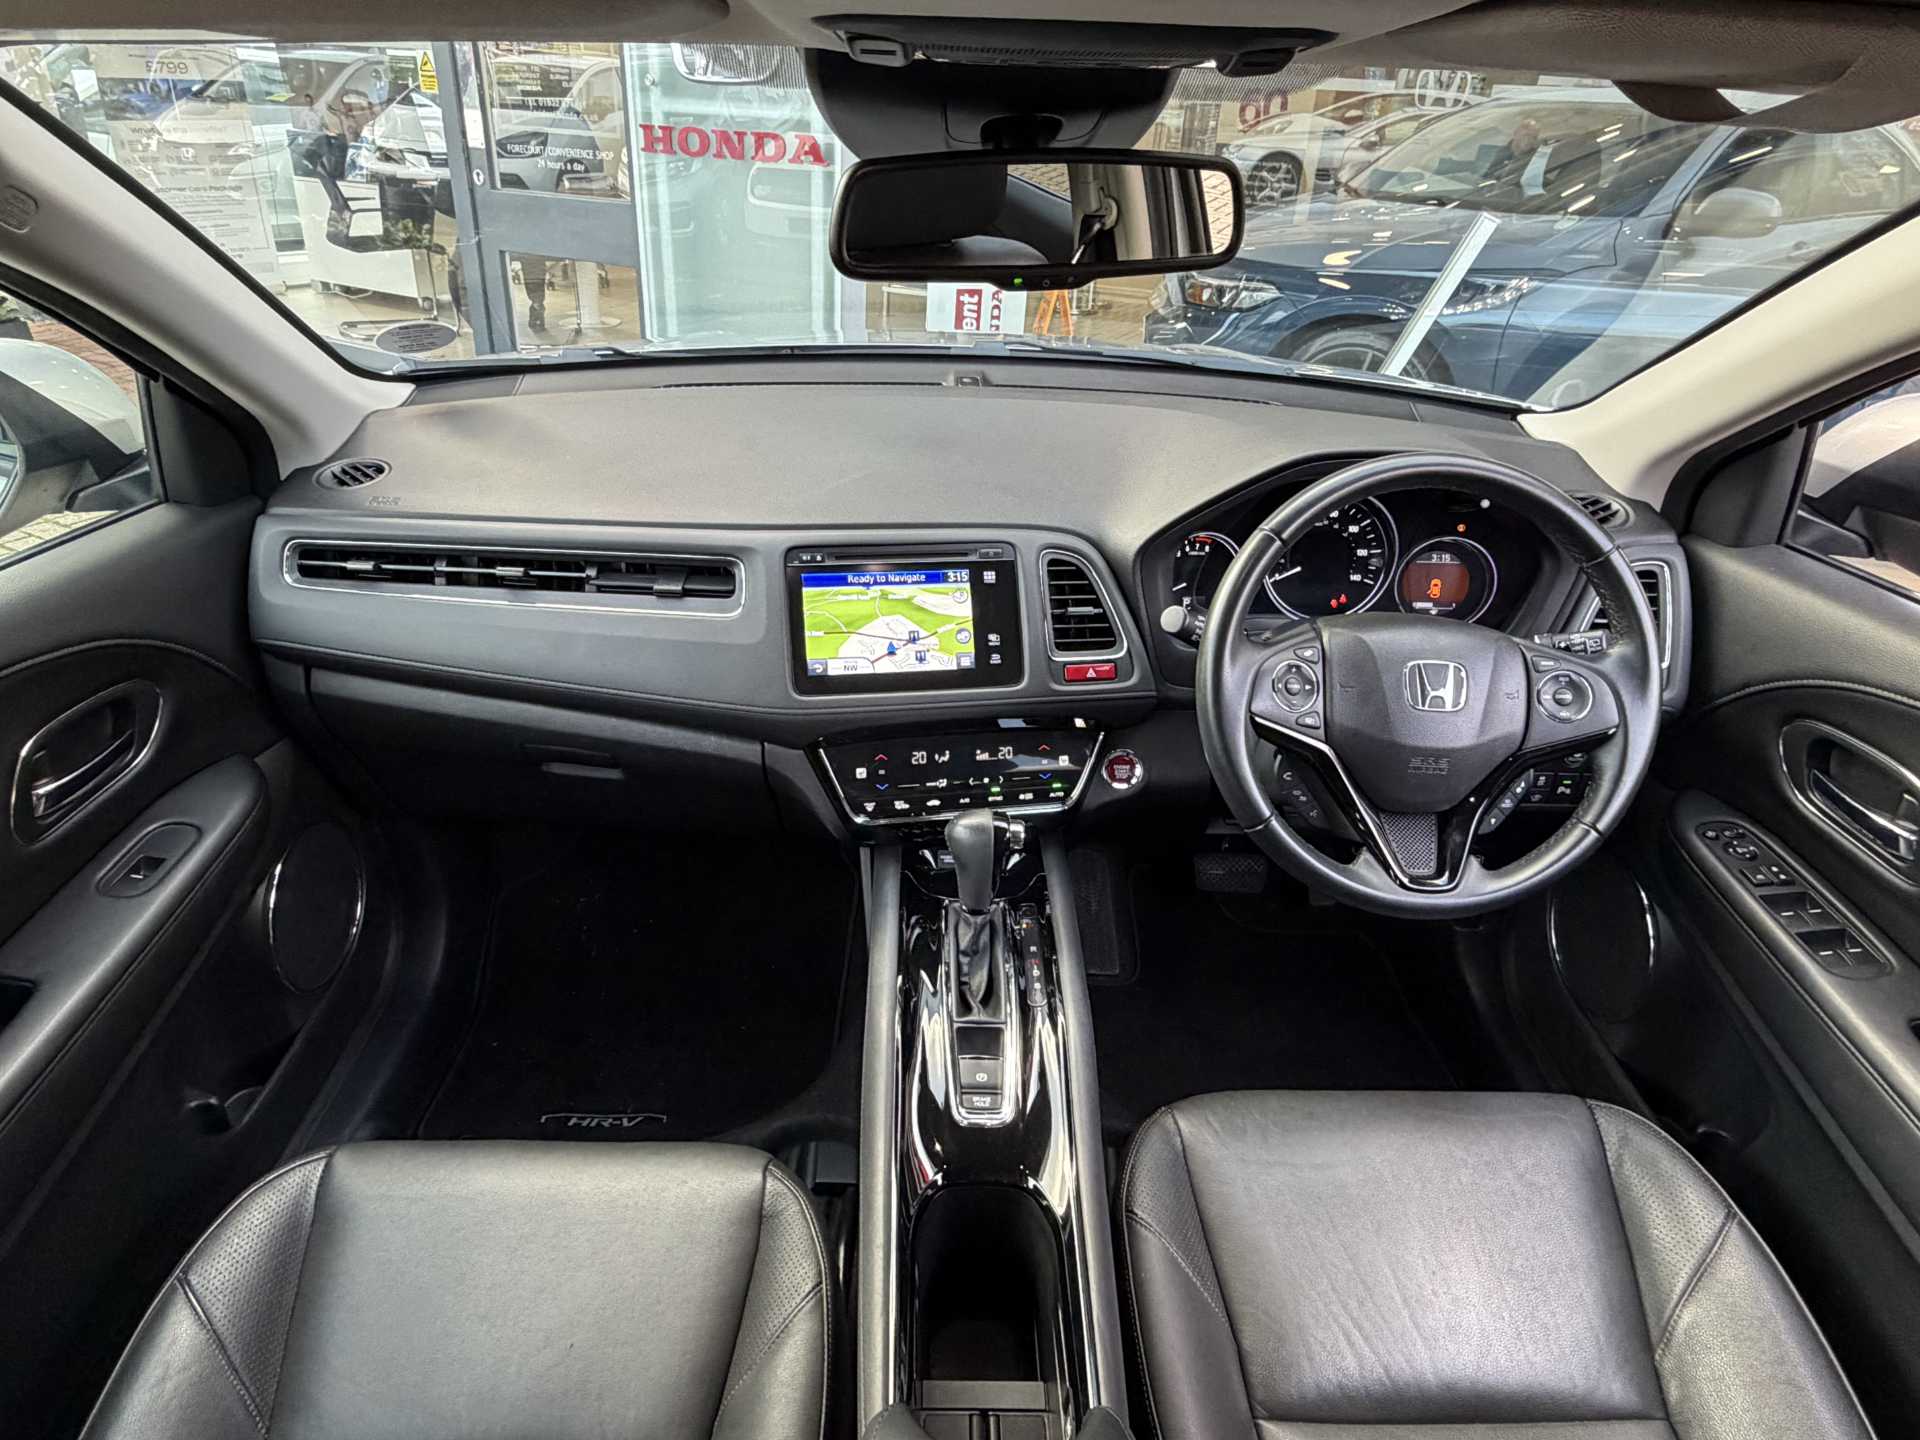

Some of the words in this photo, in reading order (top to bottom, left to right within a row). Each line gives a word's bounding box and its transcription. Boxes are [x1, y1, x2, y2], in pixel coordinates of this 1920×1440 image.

[639, 123, 833, 168] HONDA
[595, 150, 615, 160] SHOP
[537, 159, 546, 168] 24
[547, 160, 565, 169] hours
[573, 161, 585, 171] day
[1348, 525, 1360, 533] 100
[1194, 543, 1200, 551] 7
[1356, 548, 1368, 557] 120
[1431, 553, 1451, 563] 3:15
[847, 574, 875, 585] Ready
[876, 574, 886, 582] to
[889, 573, 926, 585] Navigate
[1349, 574, 1362, 582] 140
[843, 664, 858, 673] NW
[911, 751, 927, 765] 20
[997, 746, 1013, 760] 20
[567, 1116, 645, 1128] HR-V
